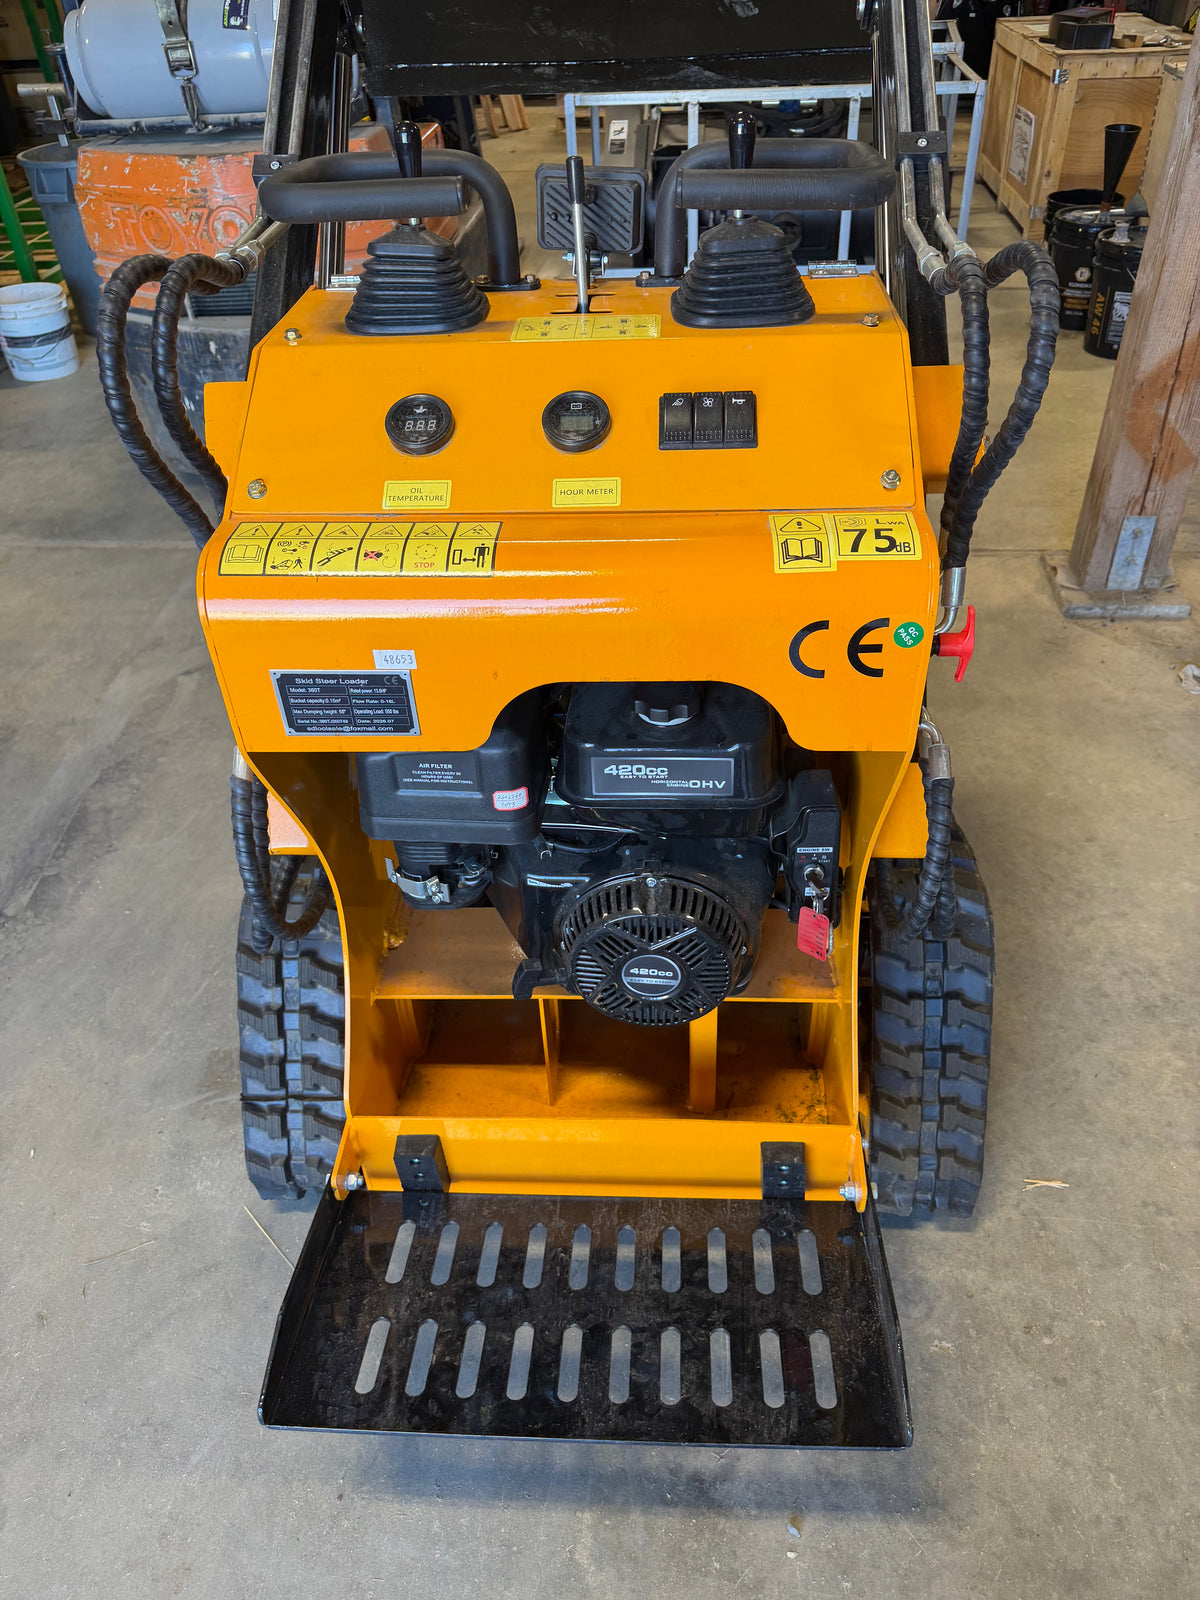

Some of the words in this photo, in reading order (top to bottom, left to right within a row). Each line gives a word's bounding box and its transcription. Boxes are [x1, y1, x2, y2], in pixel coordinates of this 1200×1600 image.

[105, 201, 257, 254] TOYO
[1094, 292, 1106, 317] AW
[1090, 319, 1100, 335] 46
[387, 494, 445, 502] TEMPERATURE
[559, 488, 584, 496] HOUR
[586, 488, 614, 496] METER
[843, 528, 897, 553] 75
[414, 561, 435, 569] STOP
[897, 628, 913, 646] PASS
[908, 626, 919, 638] QC
[788, 617, 890, 679] CE
[383, 654, 414, 665] 48653
[383, 675, 399, 685] CE
[603, 764, 669, 776] 420cc
[688, 780, 726, 789] OHV
[629, 967, 674, 977] 420cc
